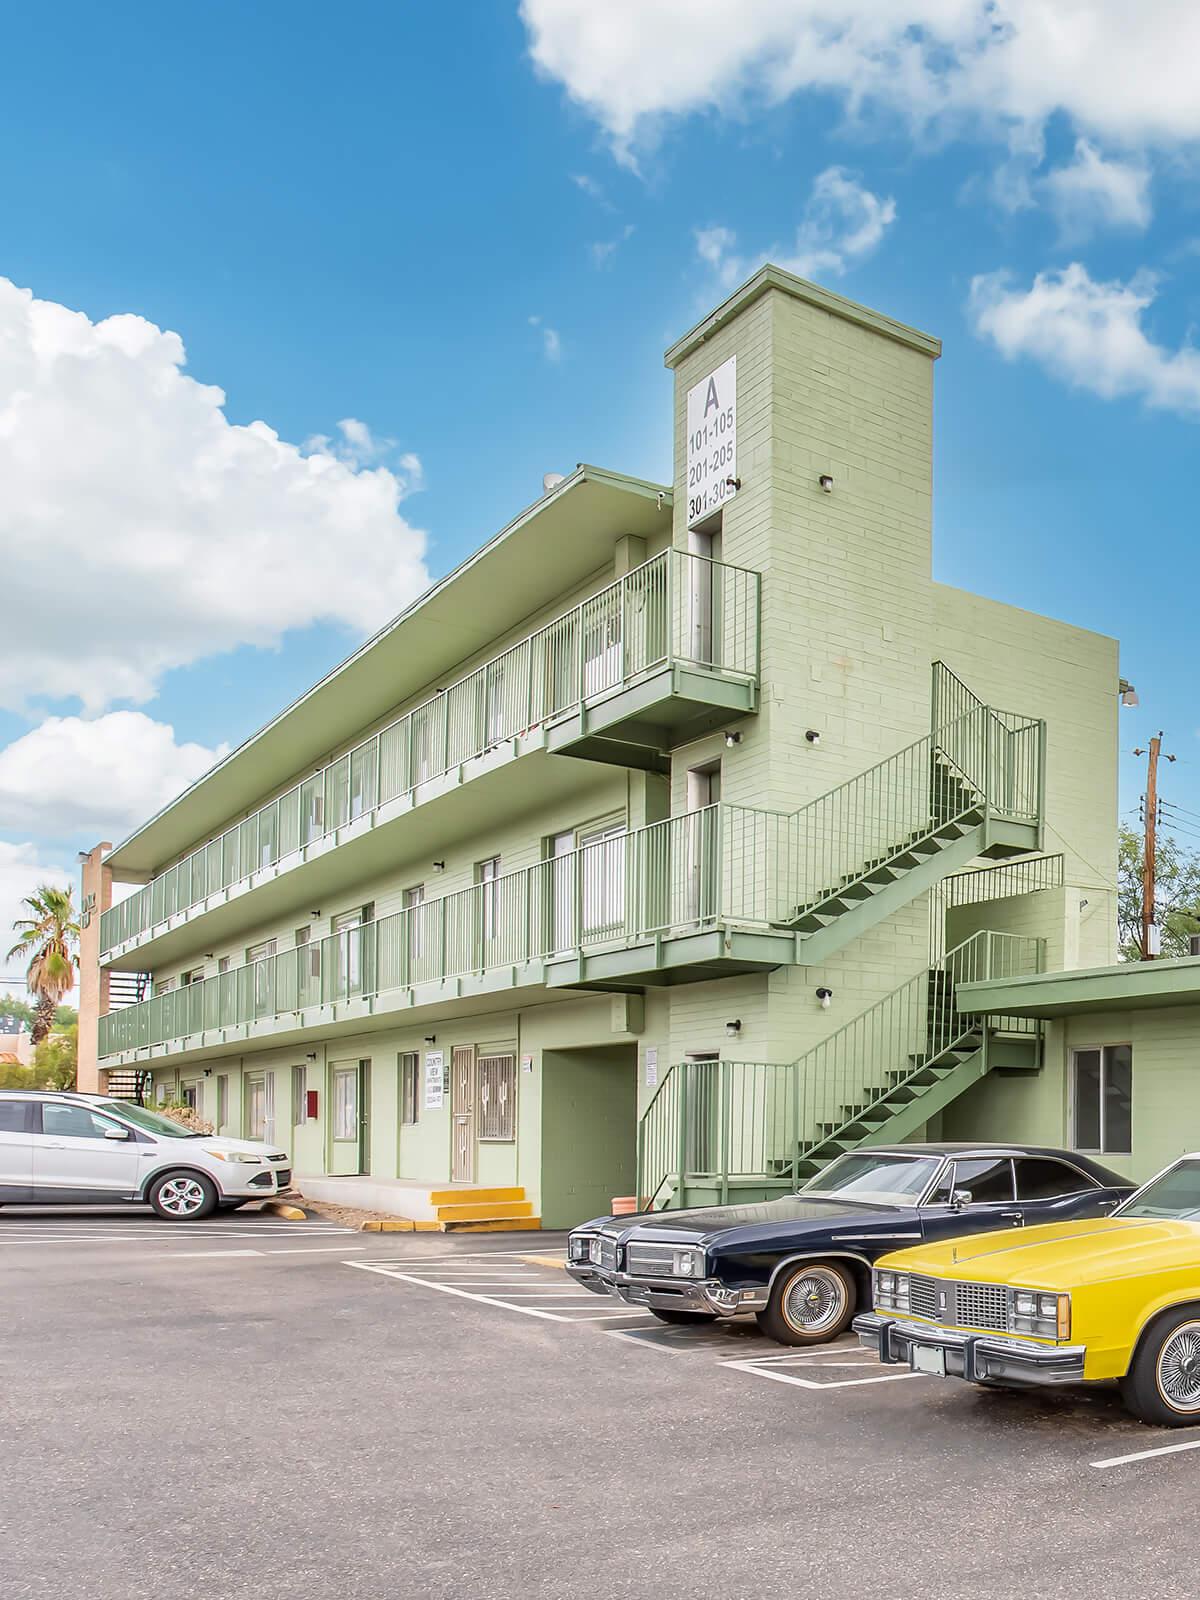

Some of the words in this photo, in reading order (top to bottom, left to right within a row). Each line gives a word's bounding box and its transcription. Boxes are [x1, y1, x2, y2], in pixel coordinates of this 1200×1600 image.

[703, 375, 720, 419] A
[689, 406, 734, 455] 101-105
[689, 440, 734, 489] 201-205
